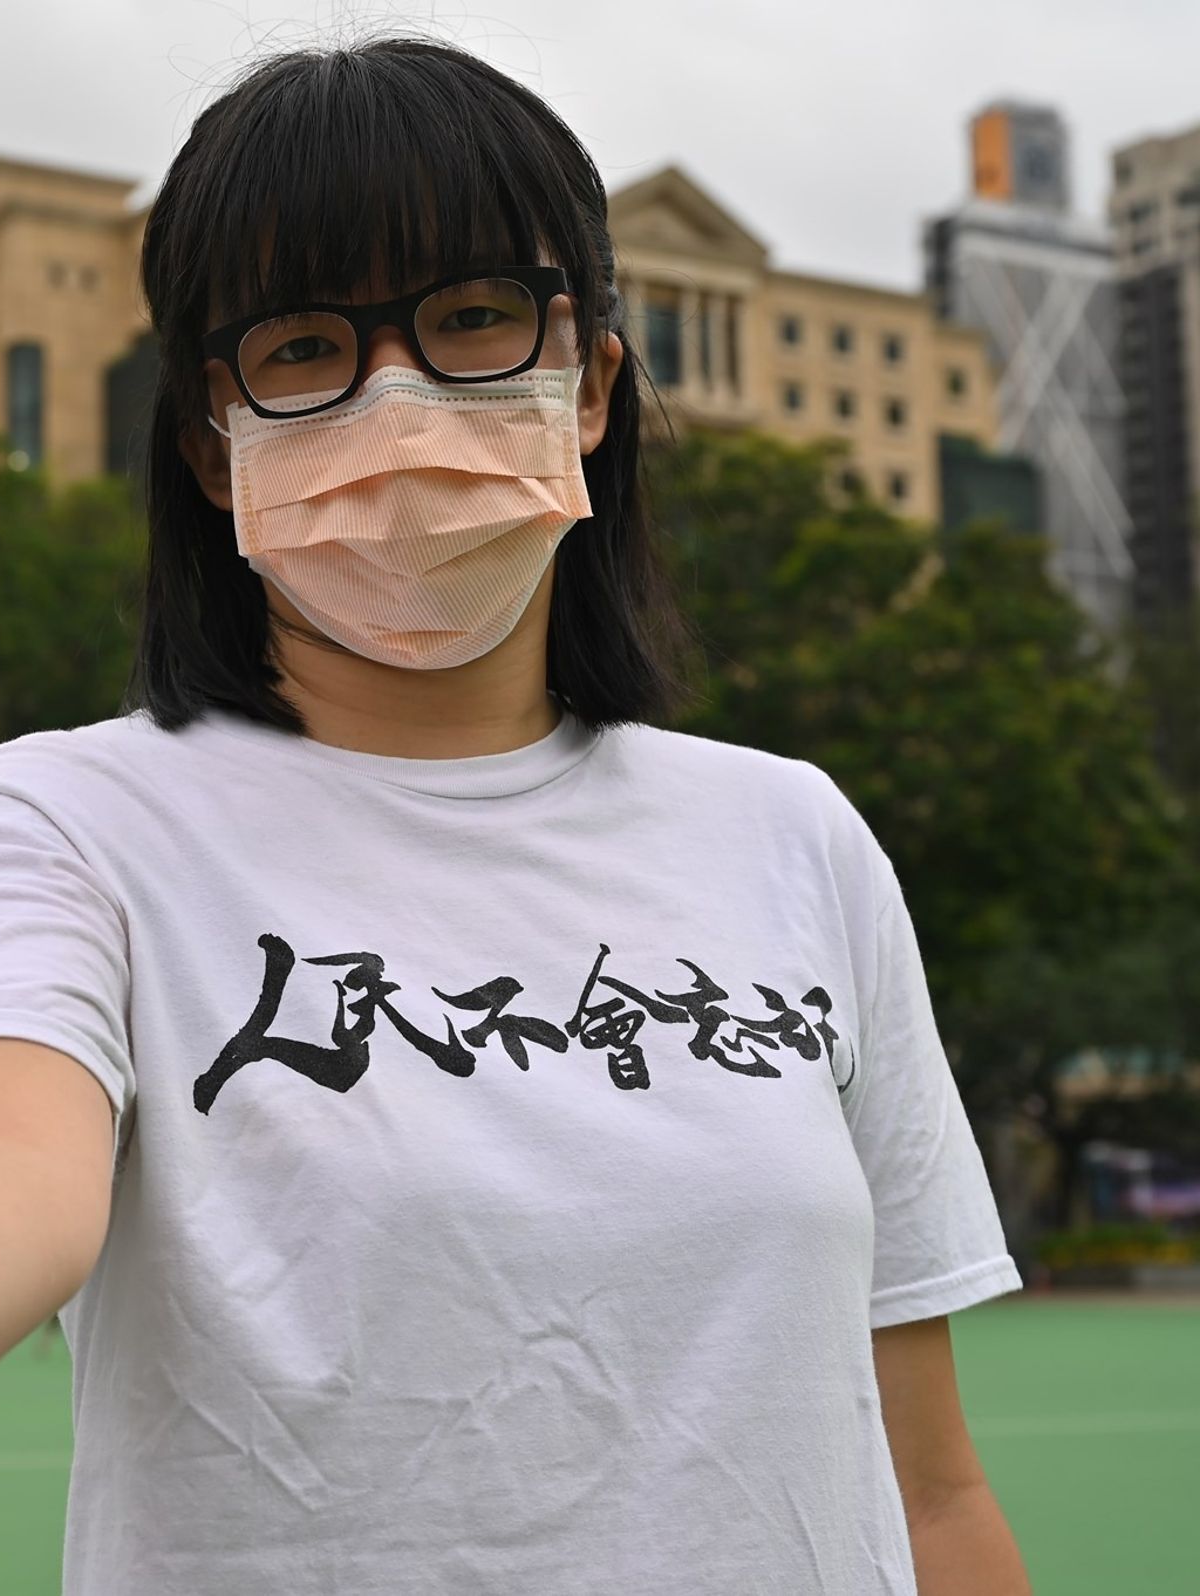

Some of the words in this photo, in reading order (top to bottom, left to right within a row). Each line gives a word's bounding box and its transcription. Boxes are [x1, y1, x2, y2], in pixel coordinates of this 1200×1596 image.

[193, 933, 855, 1115] 人民不會忘記
